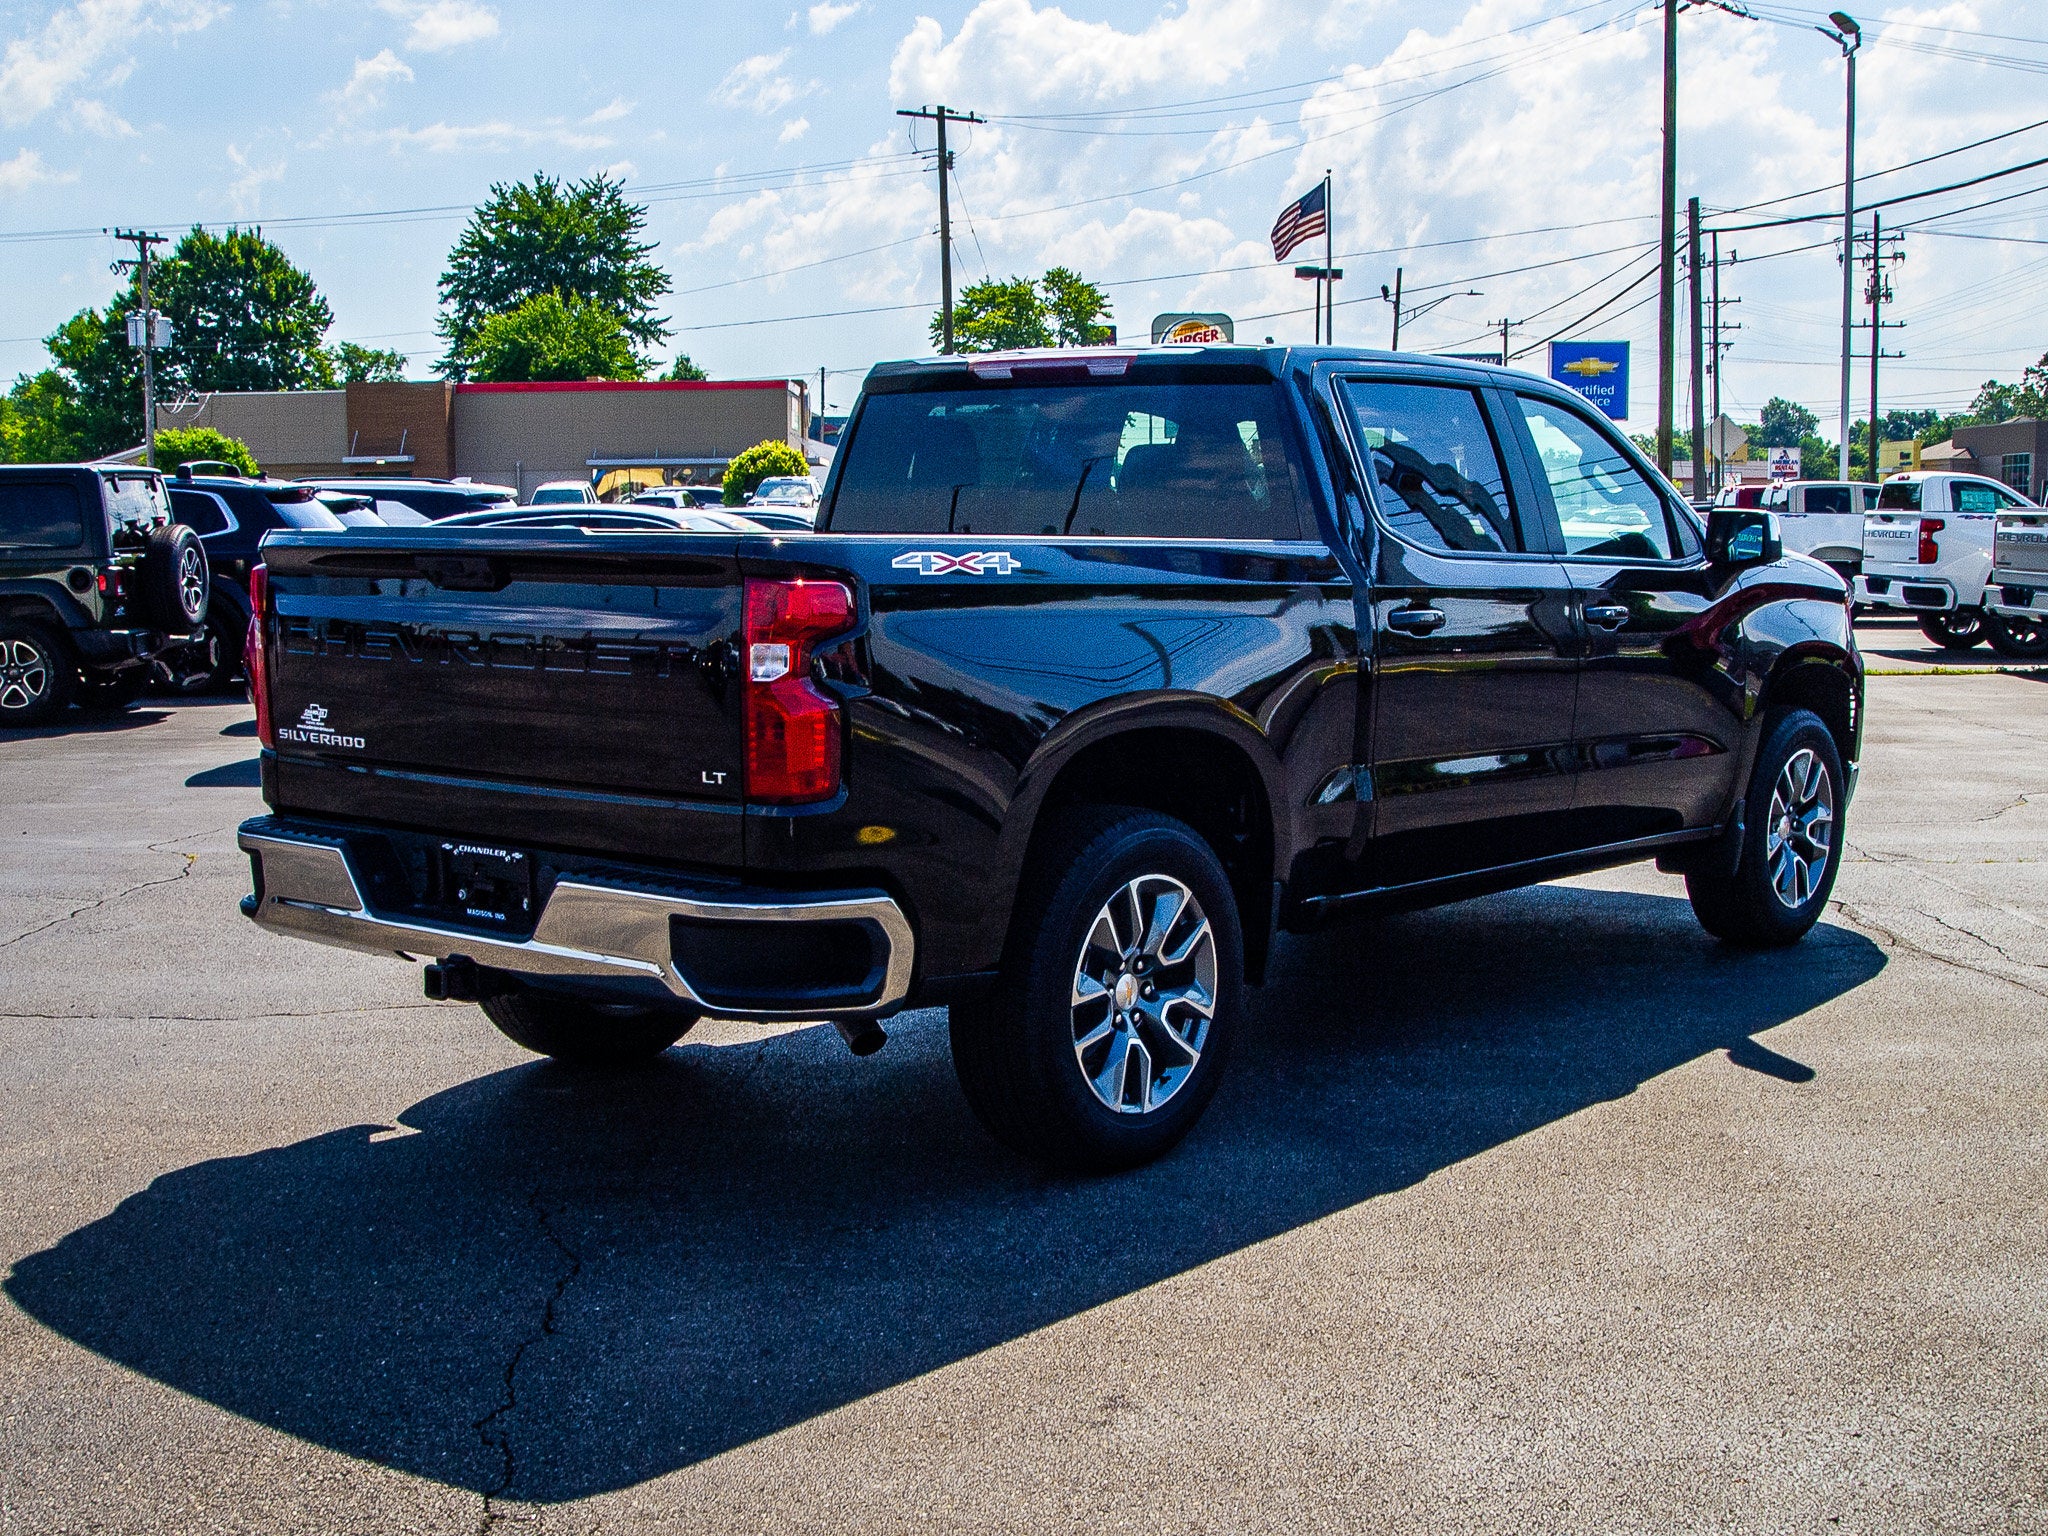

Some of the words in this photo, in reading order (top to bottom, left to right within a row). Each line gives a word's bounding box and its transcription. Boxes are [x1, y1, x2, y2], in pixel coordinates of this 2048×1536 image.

[1570, 384, 1615, 395] ertified
[1864, 530, 1913, 539] CHEVROLET
[1997, 532, 2048, 544] CHEVROL
[284, 618, 692, 678] CHEVROLET
[279, 728, 366, 749] SILVERADO
[702, 771, 727, 784] LT
[458, 845, 507, 857] CHANDLER
